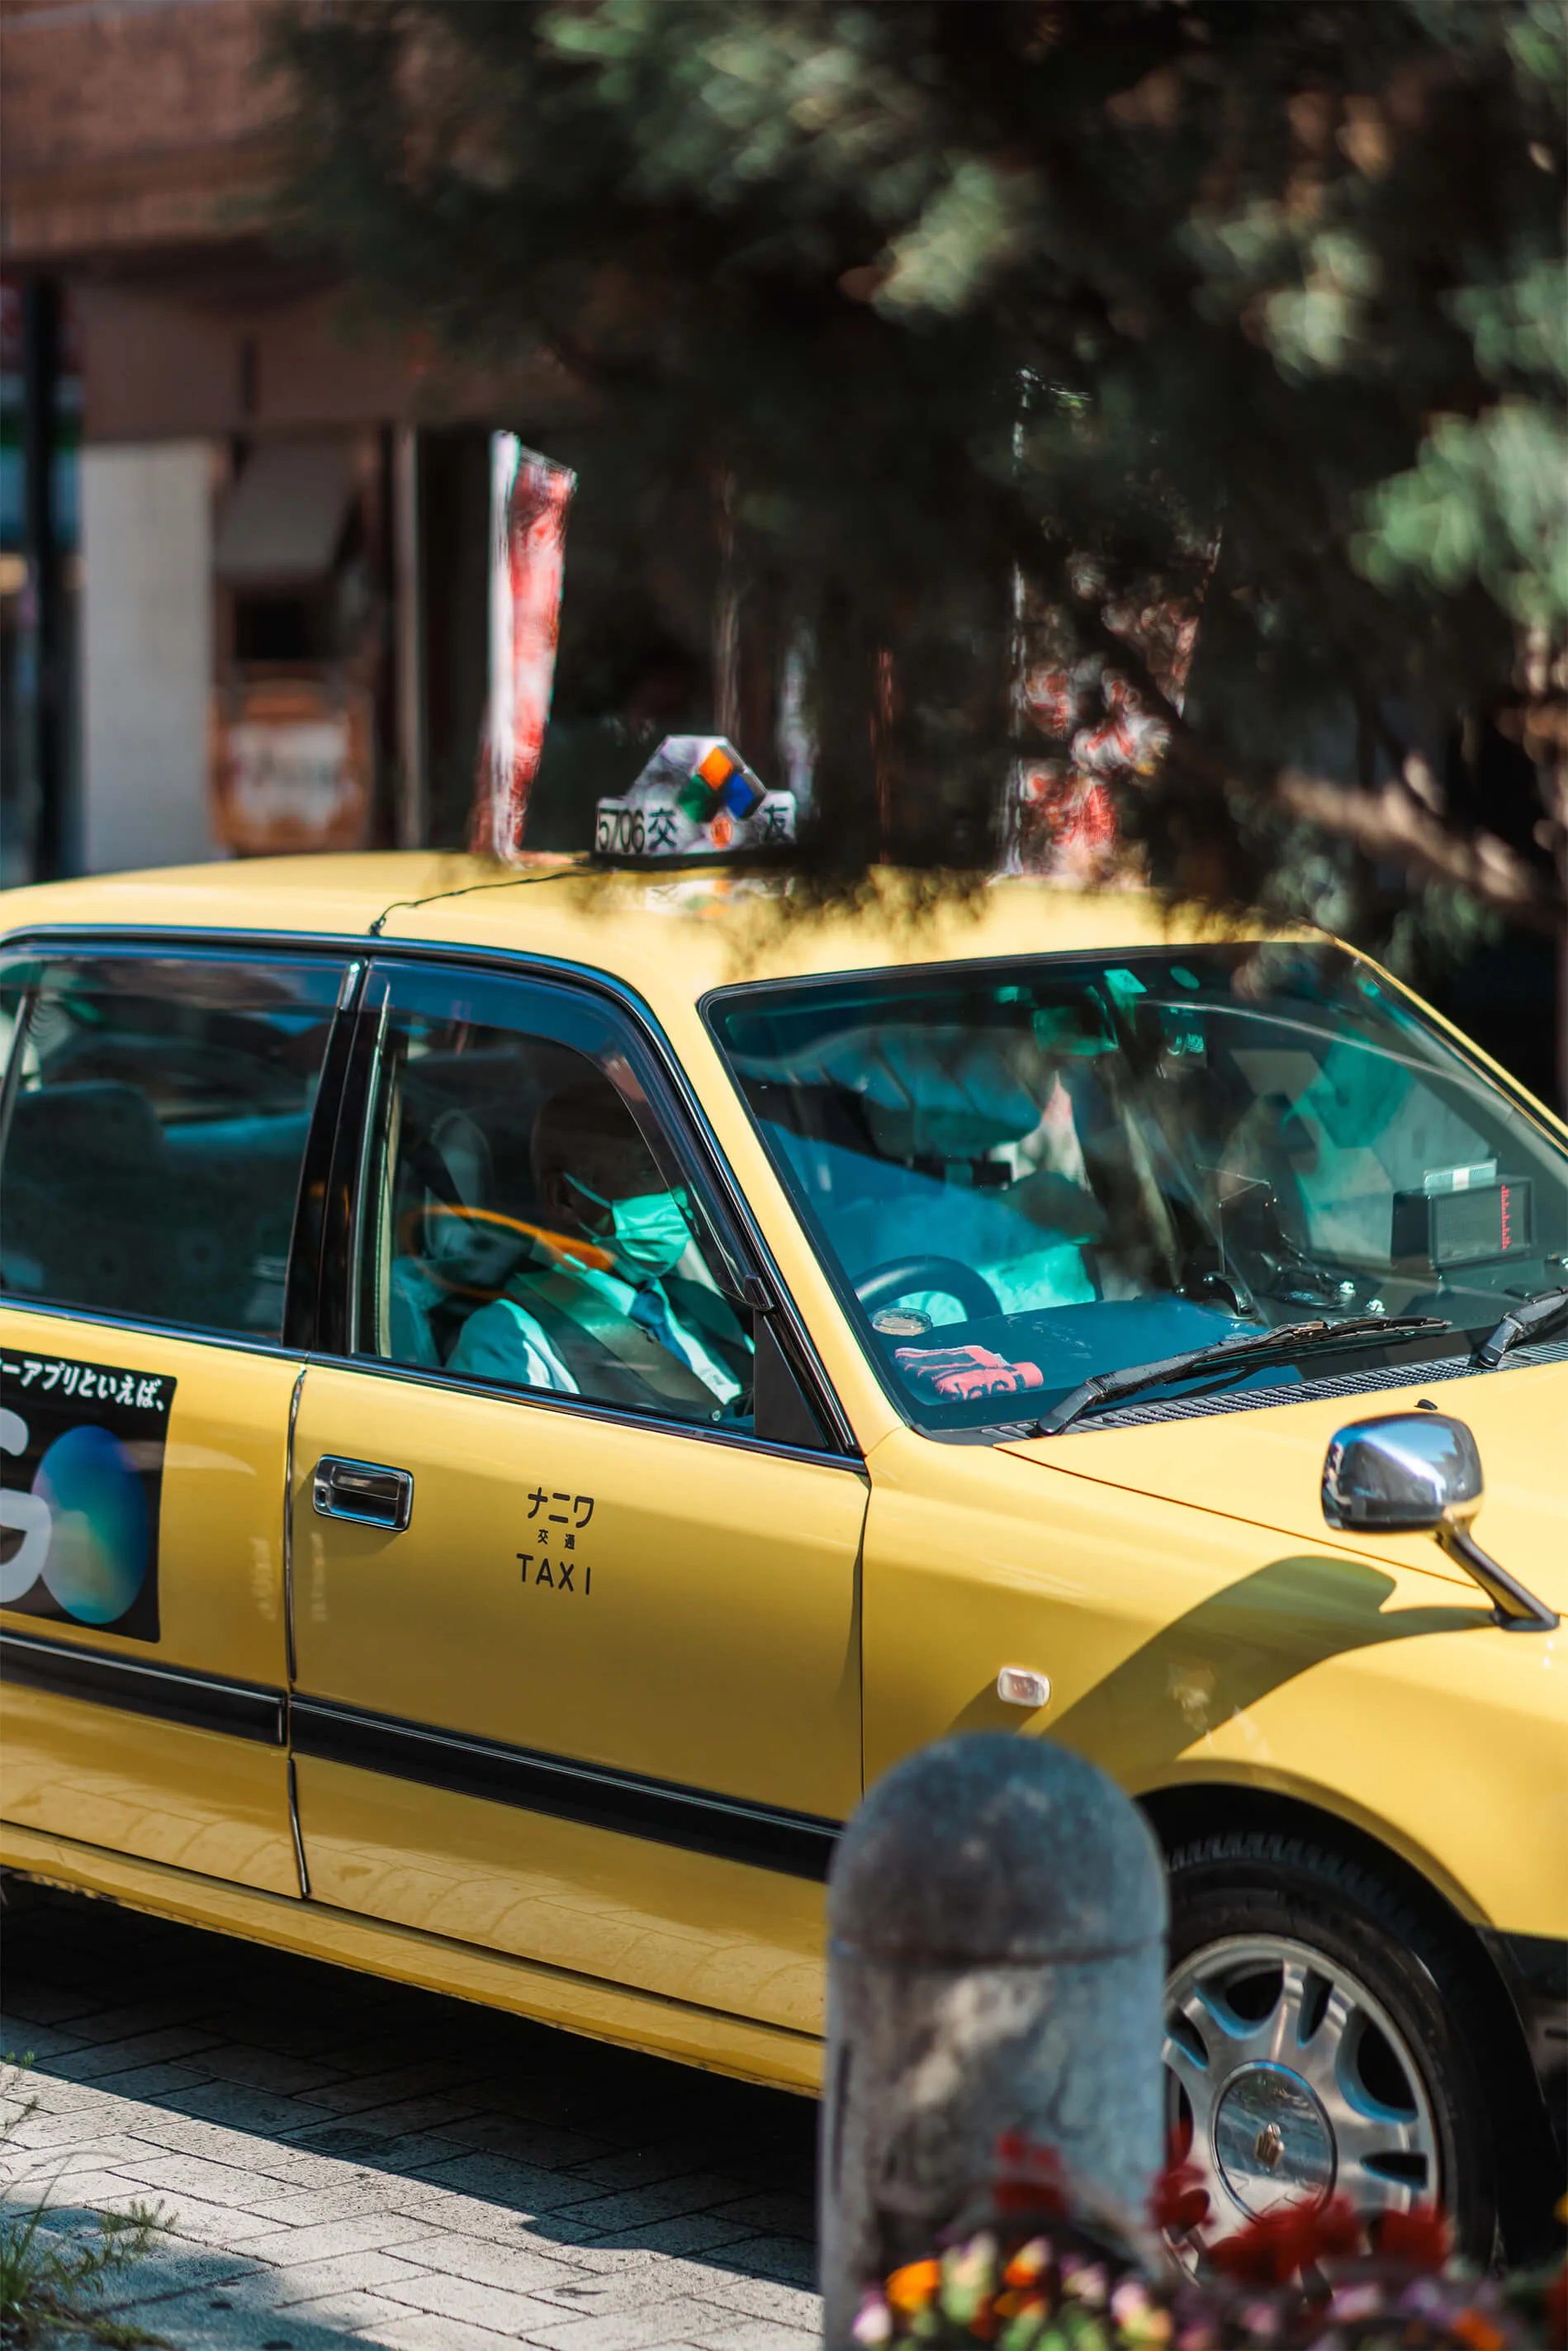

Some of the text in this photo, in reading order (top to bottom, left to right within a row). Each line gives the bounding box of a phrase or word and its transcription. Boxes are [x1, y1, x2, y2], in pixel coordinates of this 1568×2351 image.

[597, 806, 646, 854] 5706
[647, 807, 677, 851] 交
[0, 1356, 164, 1411] ーアプリといえば、
[527, 1486, 595, 1529] ナニワ
[537, 1529, 576, 1550] 交通
[516, 1552, 591, 1595] TAXI
